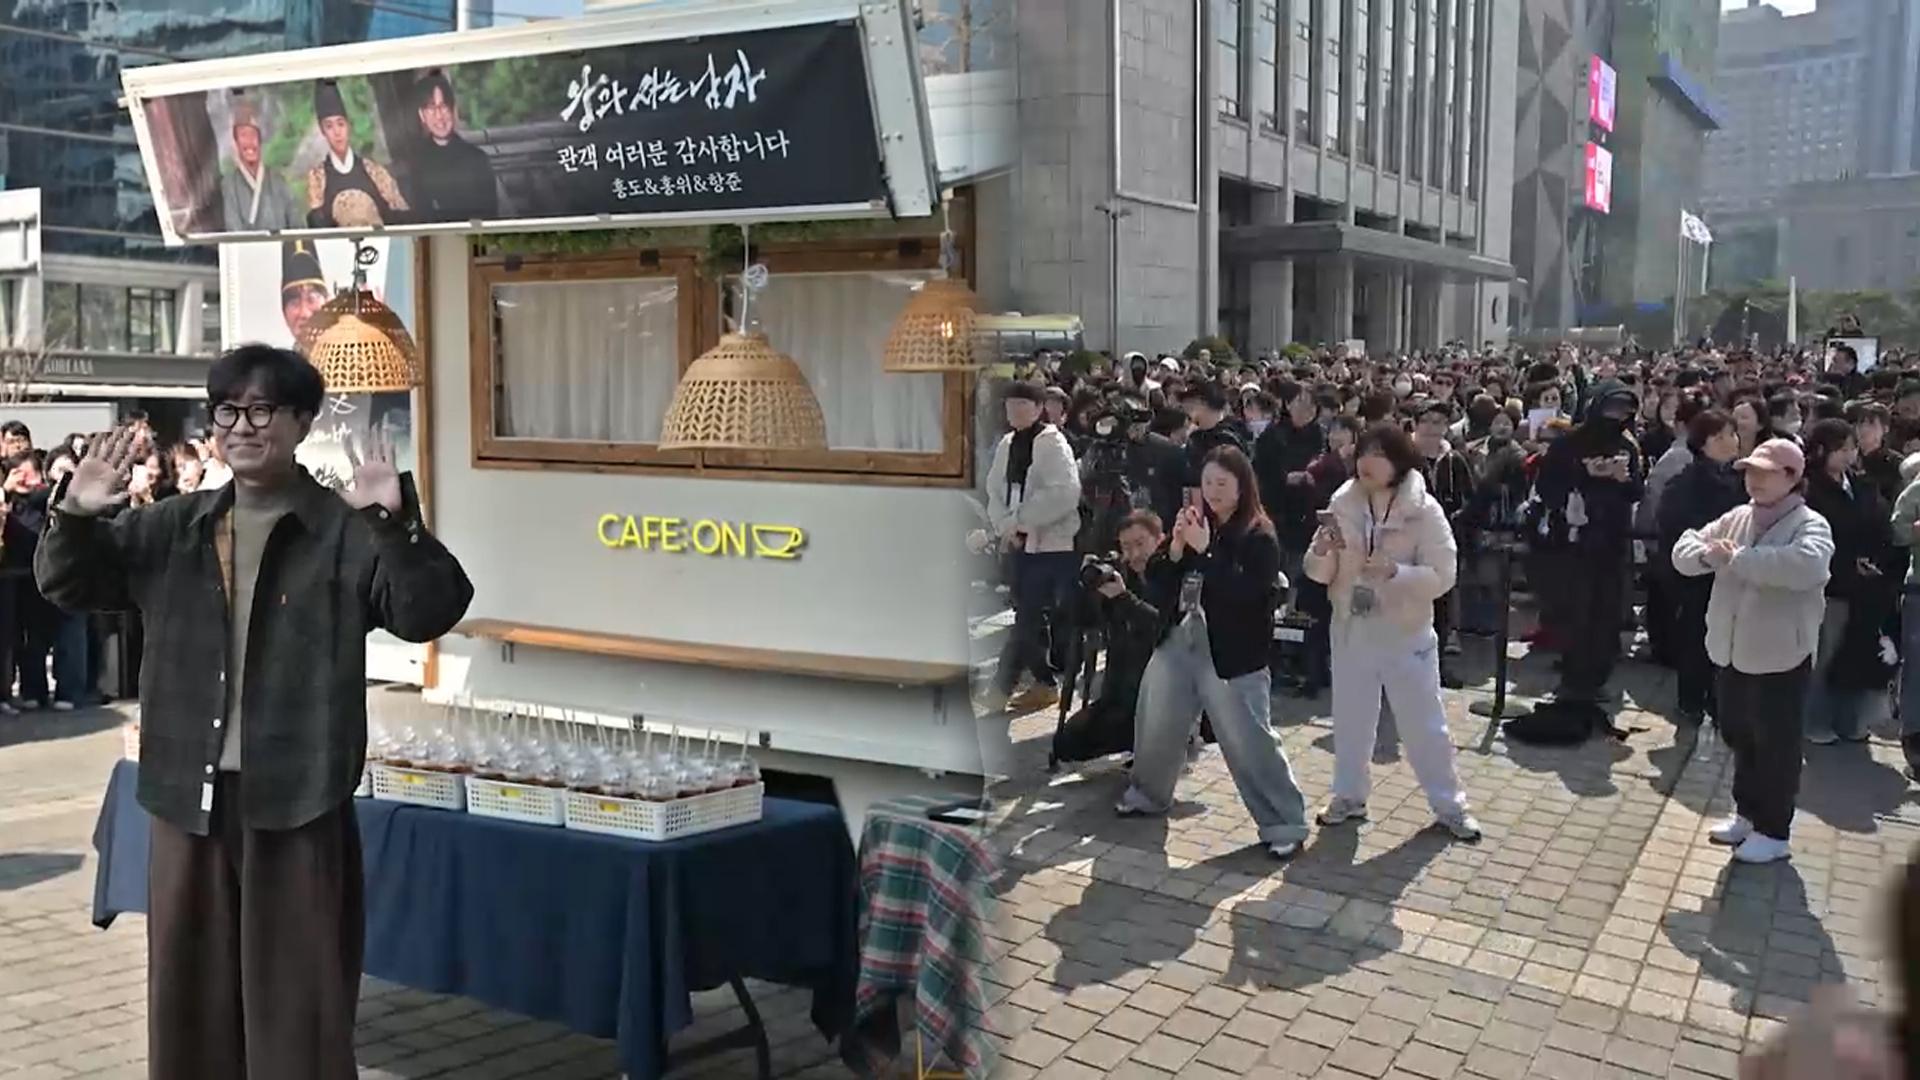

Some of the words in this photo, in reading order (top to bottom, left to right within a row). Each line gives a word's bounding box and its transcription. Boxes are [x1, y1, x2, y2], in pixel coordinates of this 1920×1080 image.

[560, 64, 628, 132] 왕과
[629, 66, 689, 111] 사는
[689, 49, 766, 109] 남자
[556, 142, 600, 173] 관객
[605, 140, 668, 170] 여러분
[674, 129, 790, 166] 감사합니다
